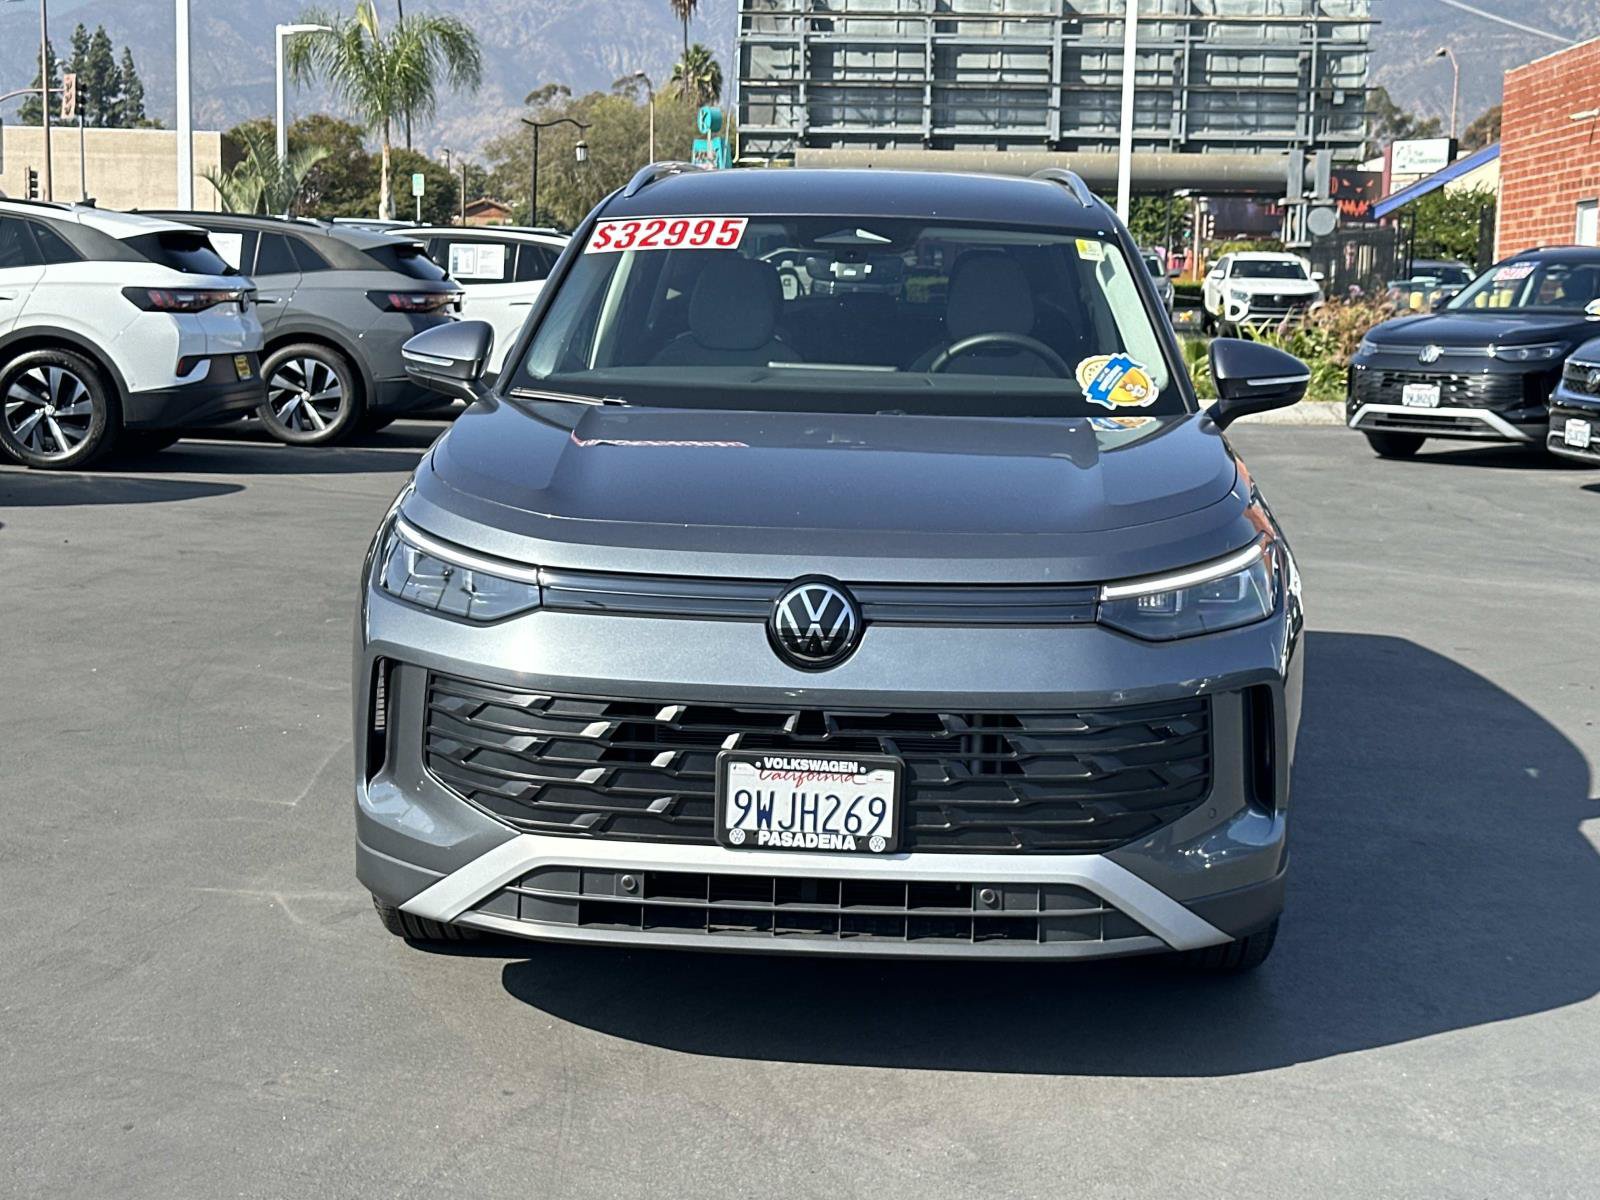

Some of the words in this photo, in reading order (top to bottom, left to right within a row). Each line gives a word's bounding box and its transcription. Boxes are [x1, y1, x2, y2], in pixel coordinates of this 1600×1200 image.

[593, 220, 743, 249] $32995
[763, 756, 858, 774] VOLKSWAGEN
[759, 768, 868, 788] California
[732, 788, 887, 836] 9WJH269
[758, 831, 857, 851] PASADENA
